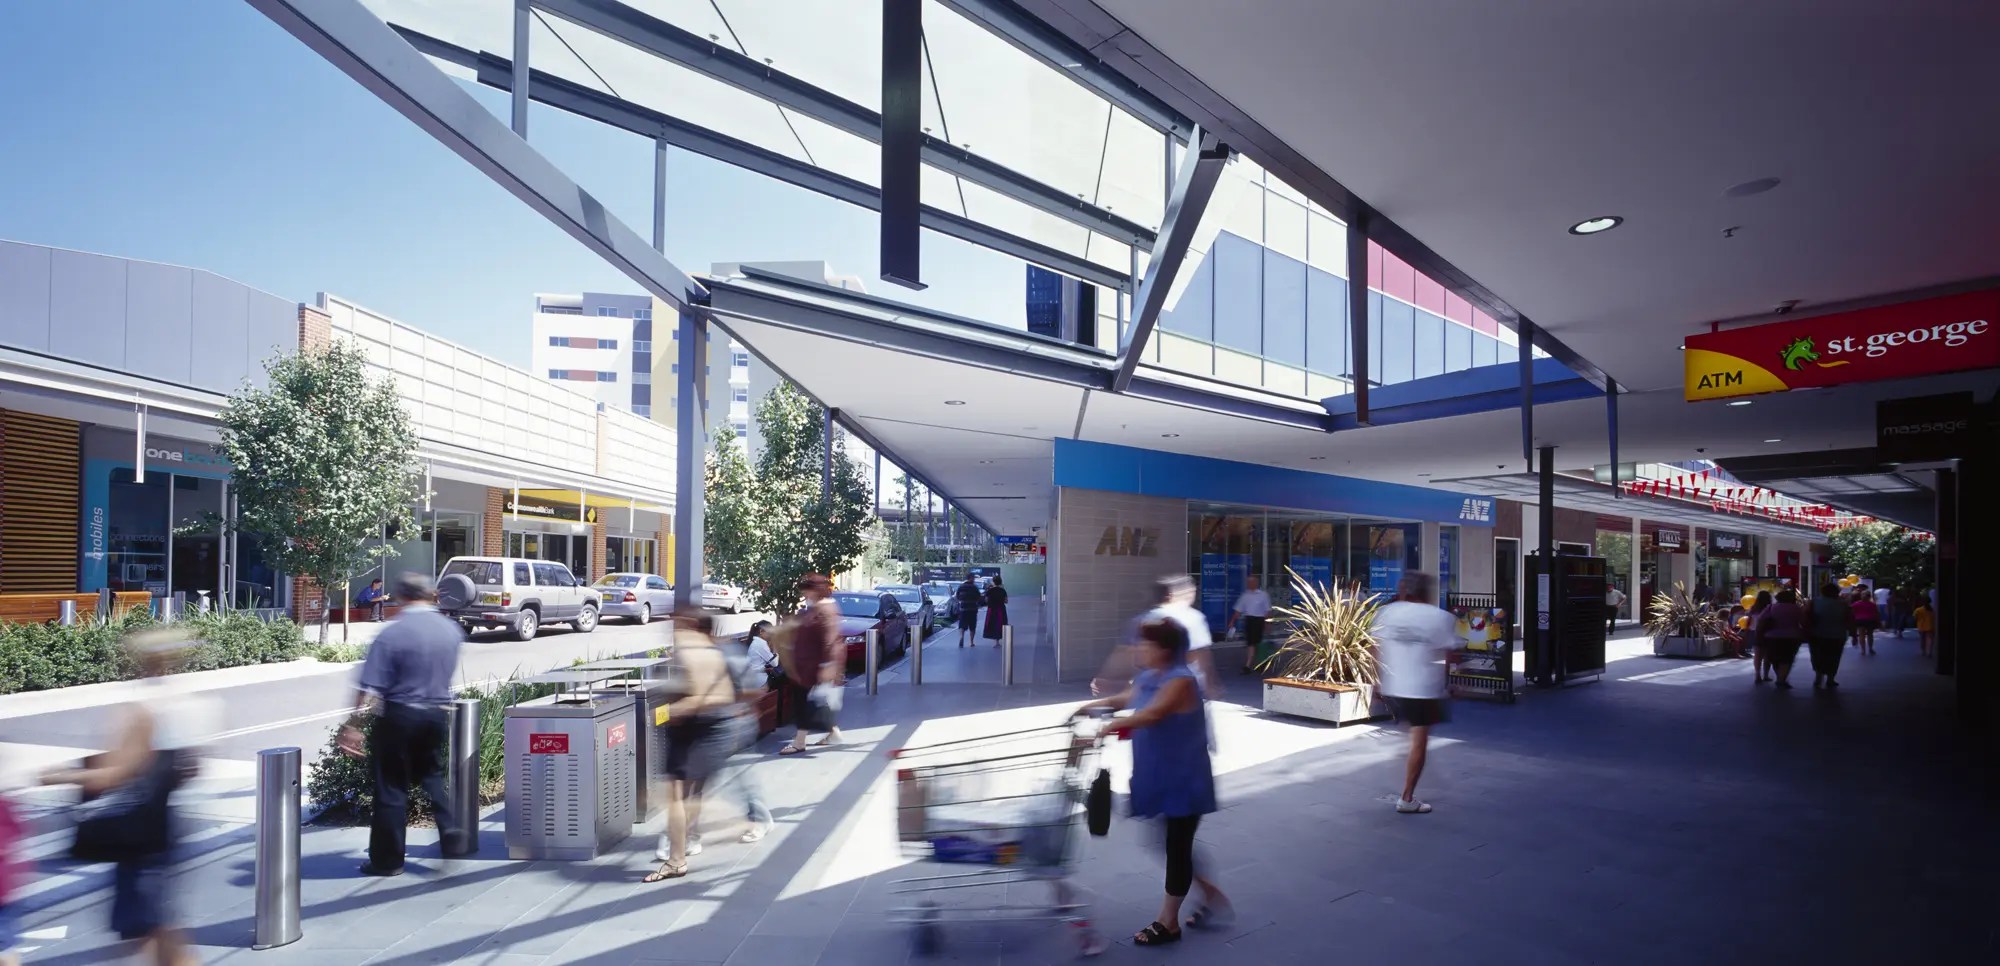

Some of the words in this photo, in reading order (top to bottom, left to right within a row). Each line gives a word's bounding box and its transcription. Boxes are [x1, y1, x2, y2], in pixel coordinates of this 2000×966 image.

[1828, 319, 1988, 357] st.george
[1697, 370, 1743, 390] ATM
[1883, 420, 1968, 436] massage
[1460, 498, 1490, 521] ANZ
[90, 507, 103, 560] mobiles
[1095, 526, 1162, 557] ANZ
